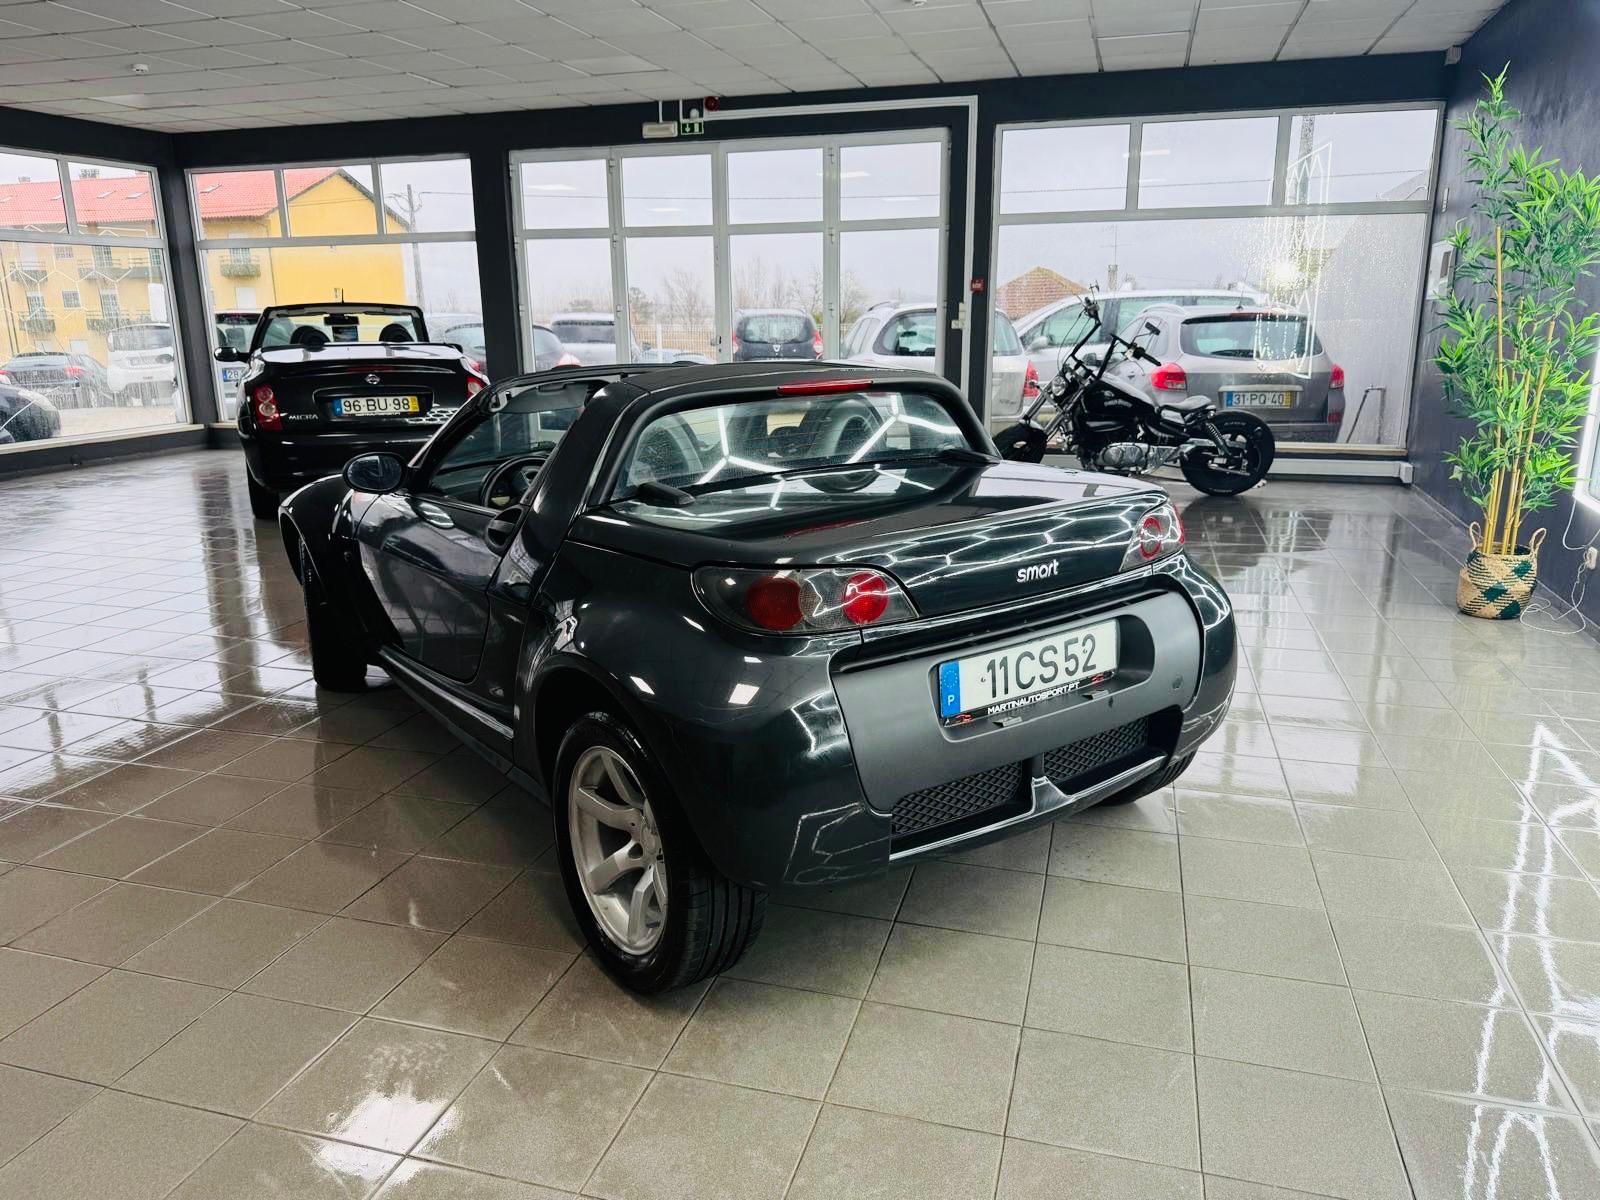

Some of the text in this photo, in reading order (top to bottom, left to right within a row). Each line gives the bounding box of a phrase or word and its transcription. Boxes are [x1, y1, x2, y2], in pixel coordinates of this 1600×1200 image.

[1016, 559, 1059, 583] smart
[947, 694, 955, 706] P
[987, 681, 1080, 715] MARTINAUTOSPORT.PT
